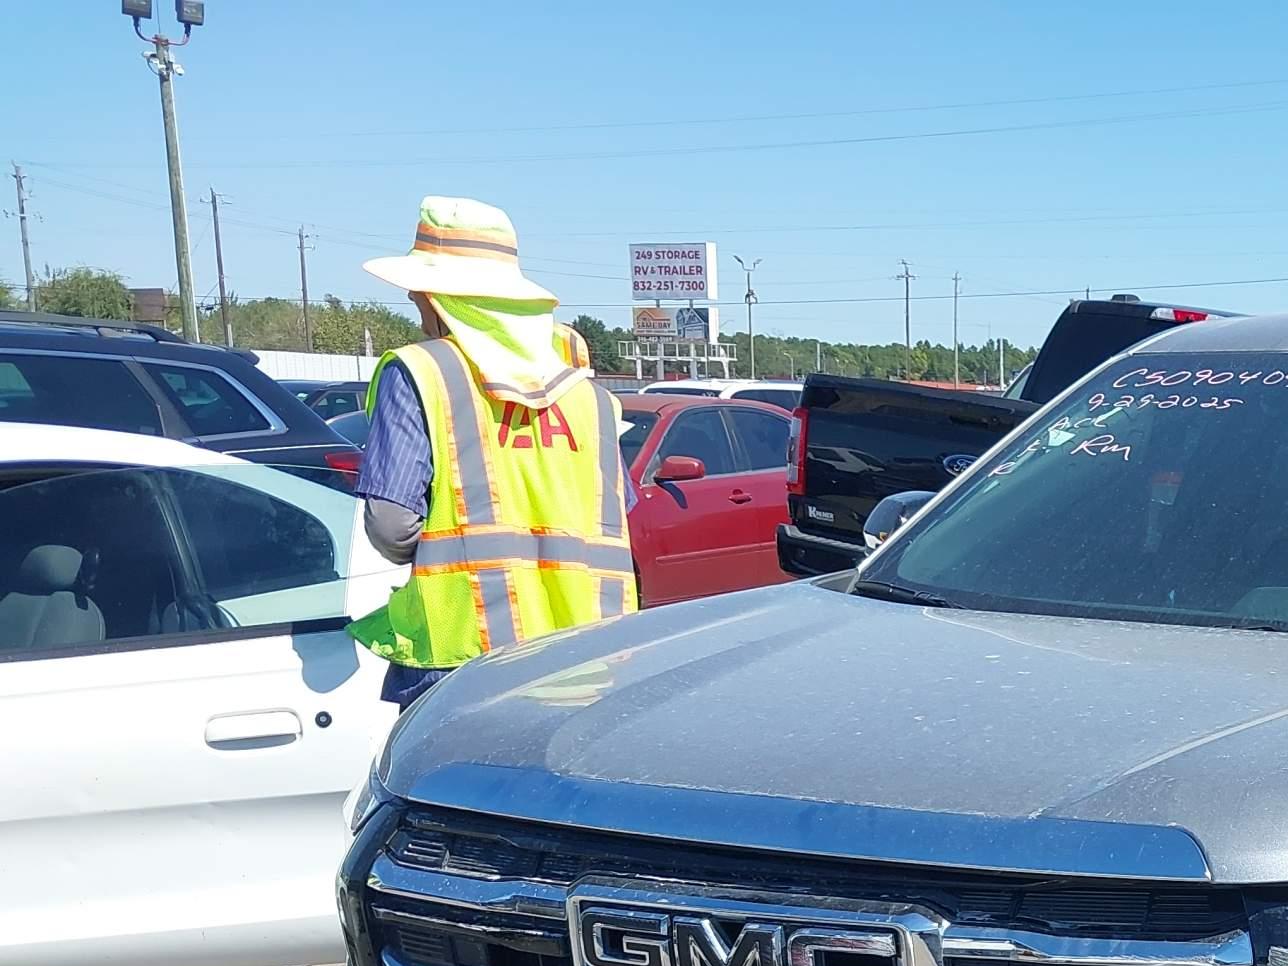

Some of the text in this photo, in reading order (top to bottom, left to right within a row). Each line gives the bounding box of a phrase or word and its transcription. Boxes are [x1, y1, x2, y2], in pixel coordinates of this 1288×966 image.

[635, 250, 701, 260] 249 STORAGE
[634, 265, 649, 276] RV
[657, 265, 703, 276] TRAILER
[633, 280, 705, 291] 832-251-7300
